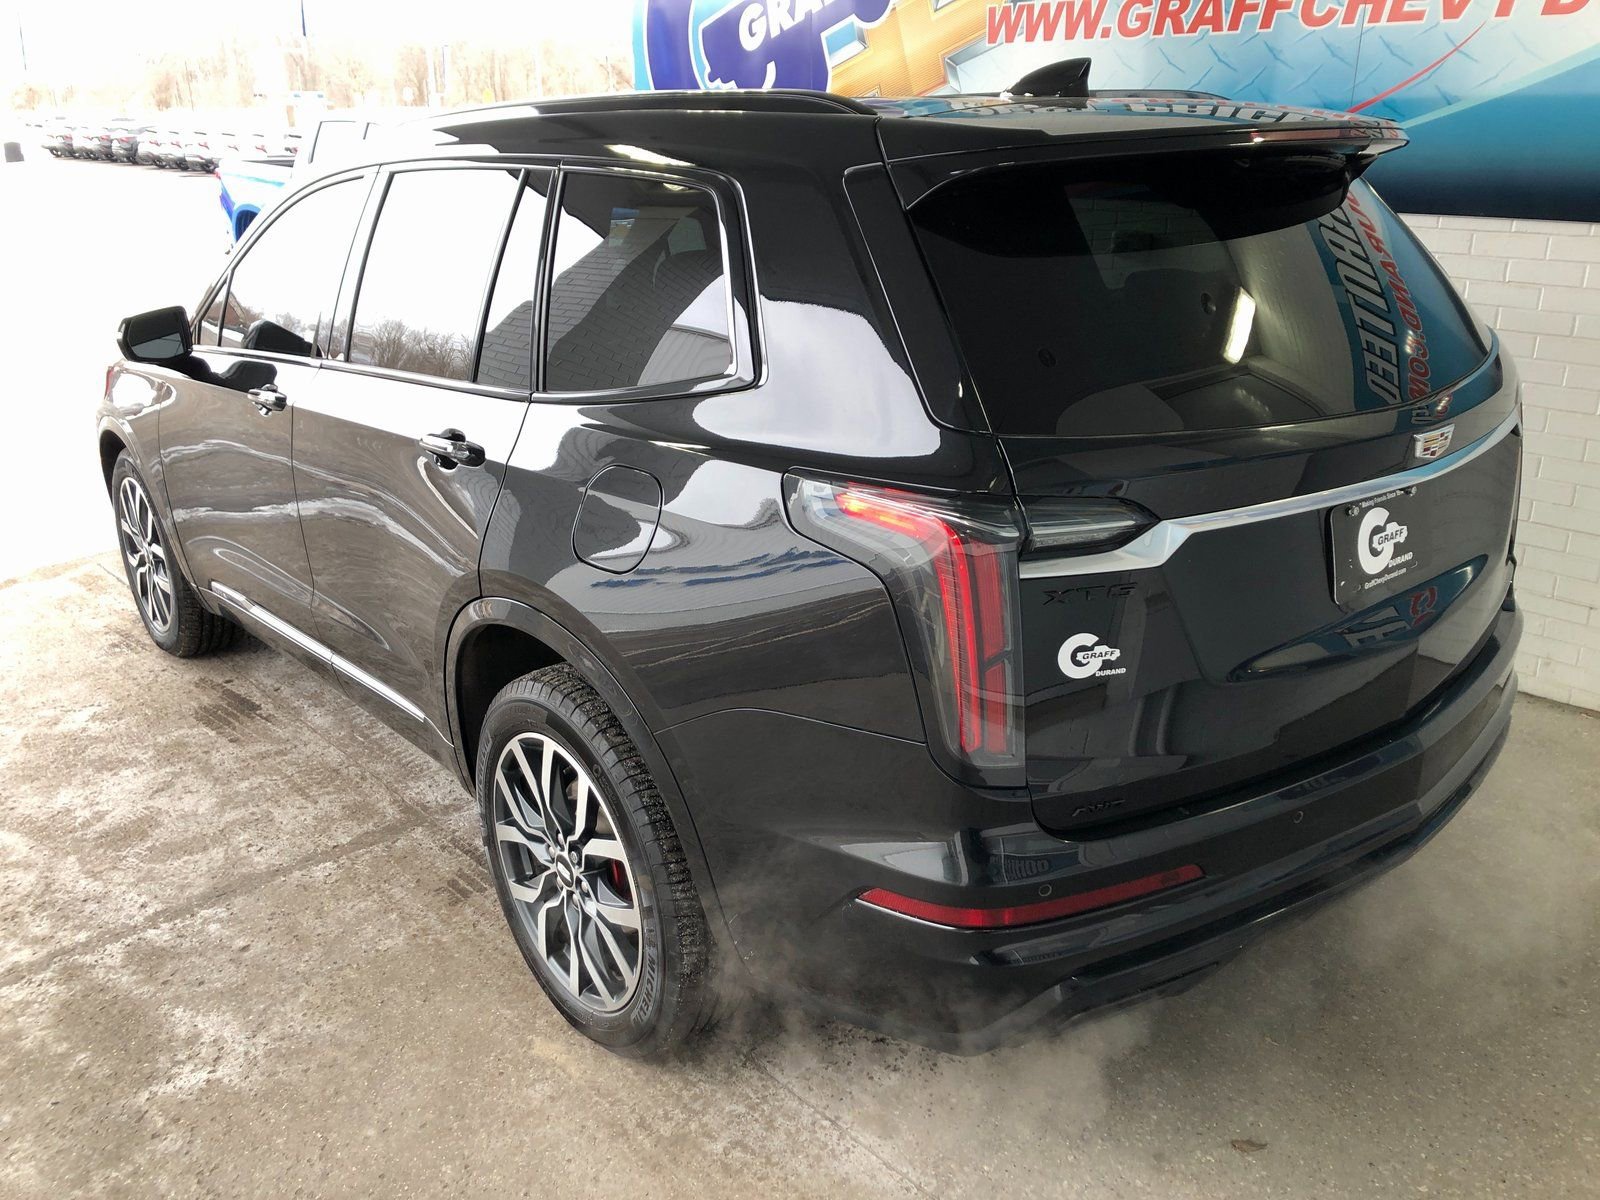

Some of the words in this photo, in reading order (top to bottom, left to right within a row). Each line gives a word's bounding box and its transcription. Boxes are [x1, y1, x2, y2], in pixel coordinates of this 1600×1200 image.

[739, 0, 835, 51] GRA
[1377, 528, 1405, 545] GRAFF
[1388, 551, 1413, 568] DURAND
[1042, 582, 1138, 606] XT6
[1082, 649, 1117, 660] GRAFF
[1095, 667, 1127, 677] DURAND
